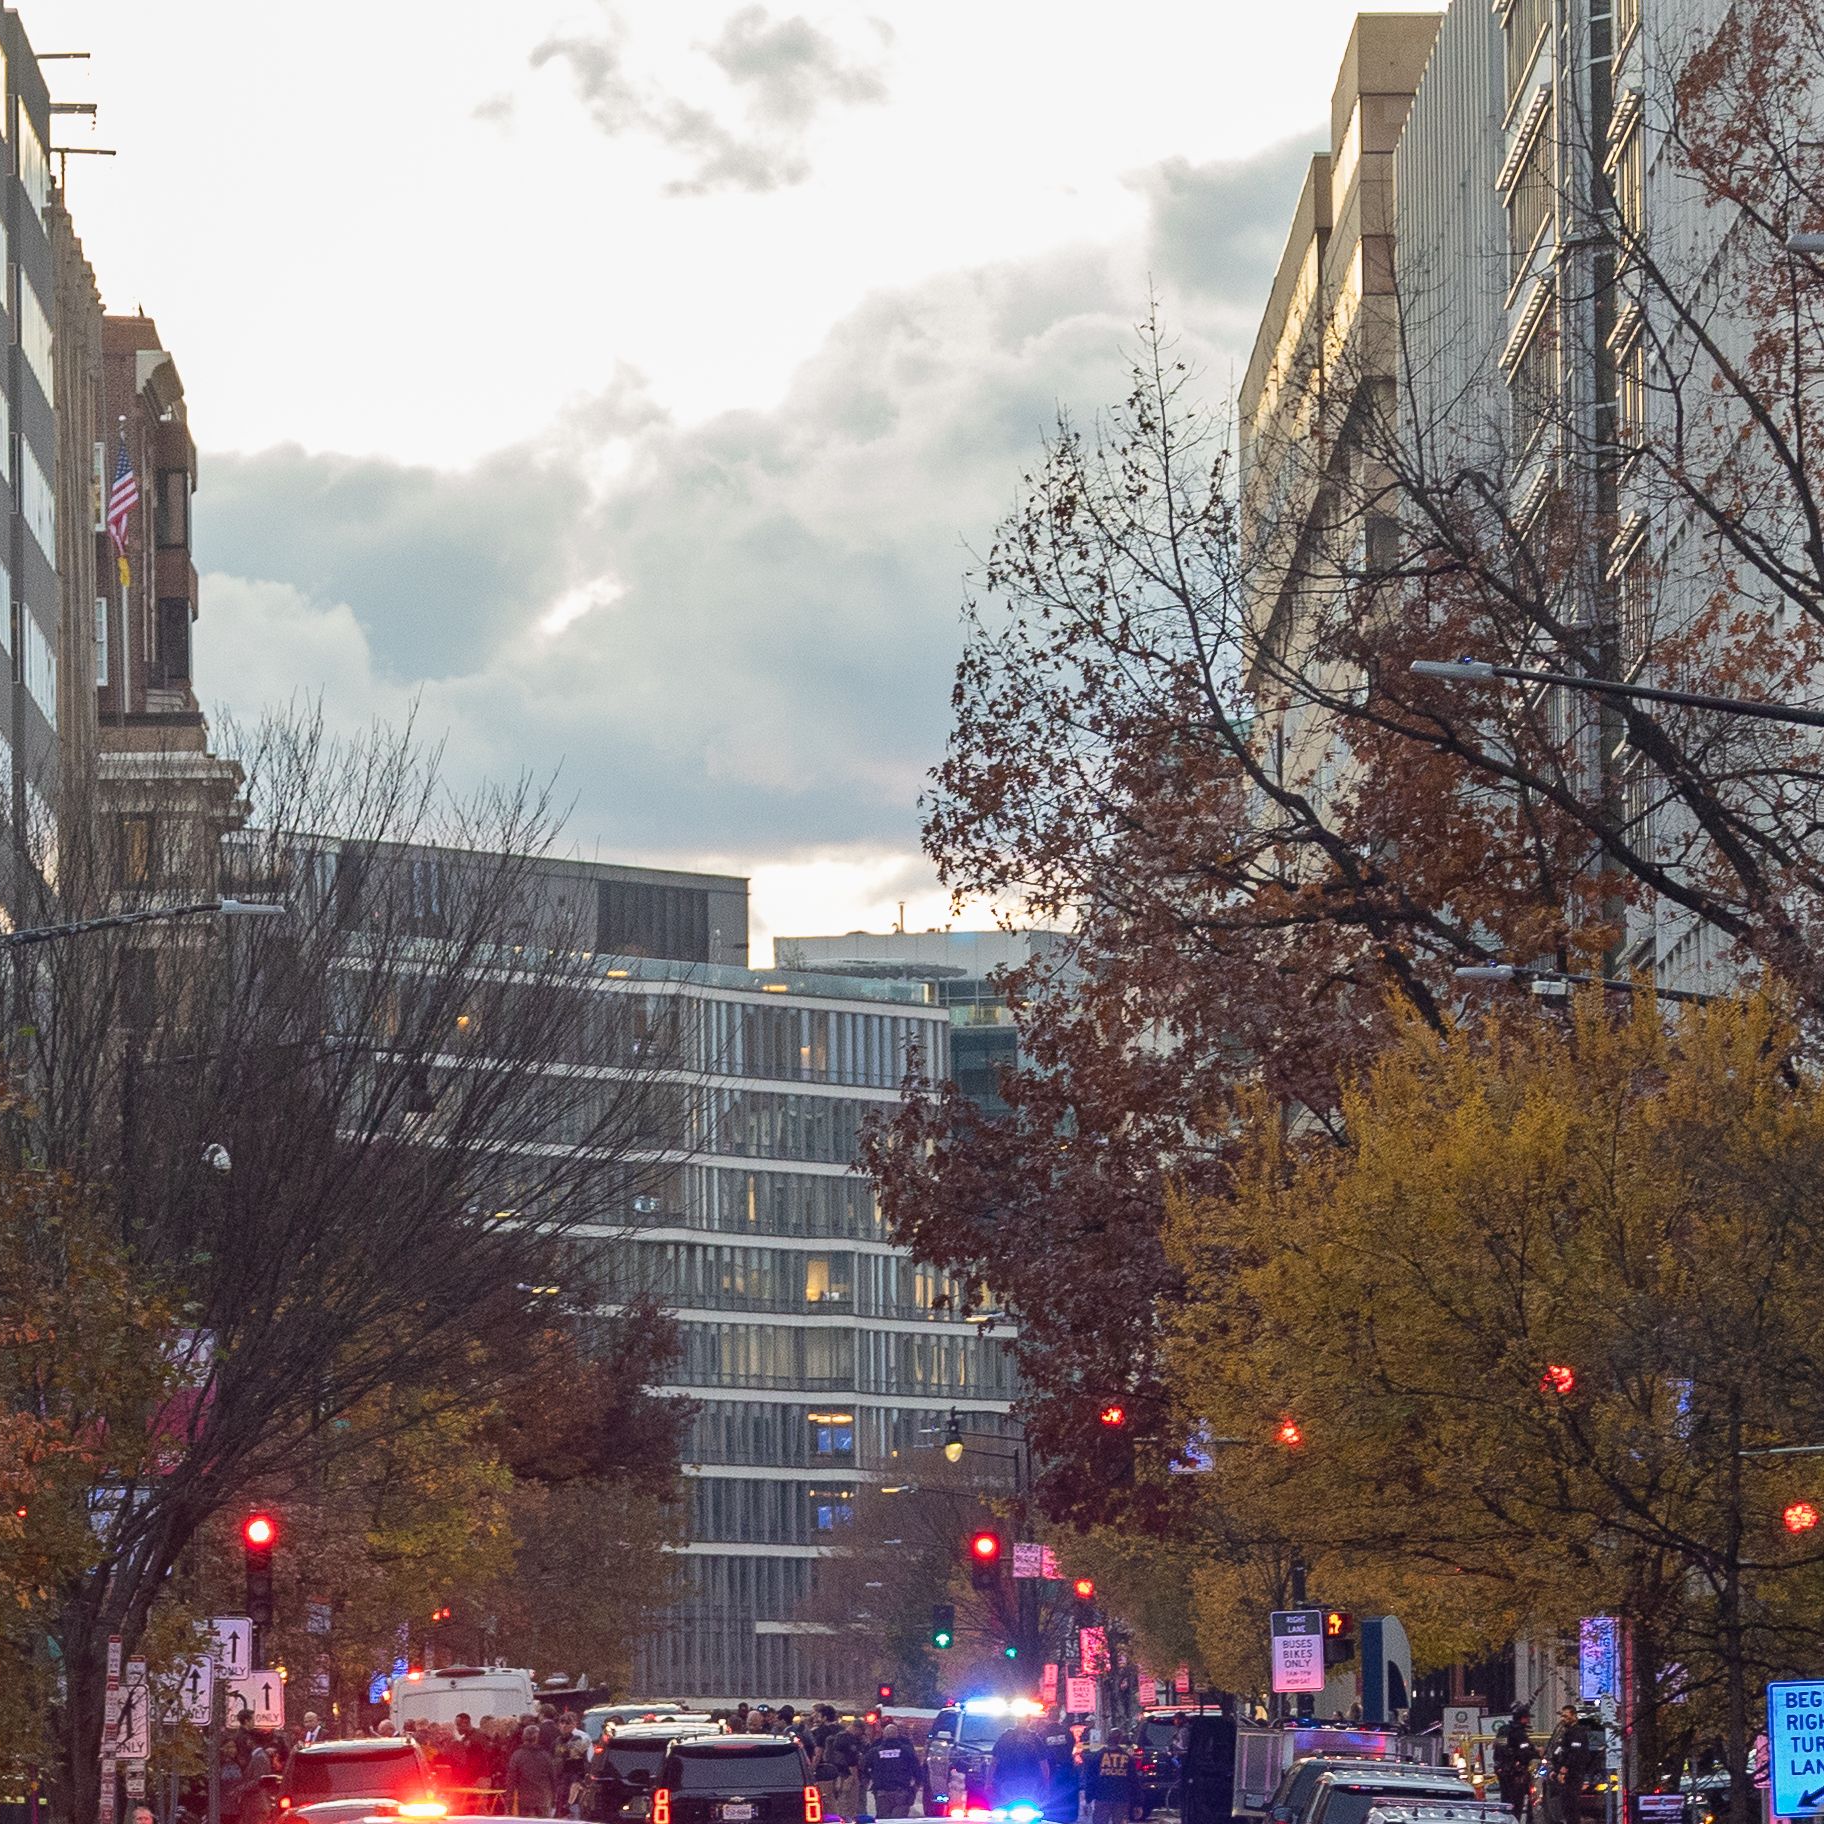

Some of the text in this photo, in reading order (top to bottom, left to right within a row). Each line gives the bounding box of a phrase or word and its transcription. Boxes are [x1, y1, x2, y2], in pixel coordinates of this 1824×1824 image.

[1288, 1625, 1306, 1633] LANE
[1283, 1640, 1313, 1648] BUSES
[1283, 1649, 1313, 1658] BIKES
[1285, 1660, 1311, 1668] ONLY
[255, 1713, 279, 1722] ONLY
[1100, 1753, 1129, 1768] ATF
[1100, 1768, 1128, 1776] POLICE
